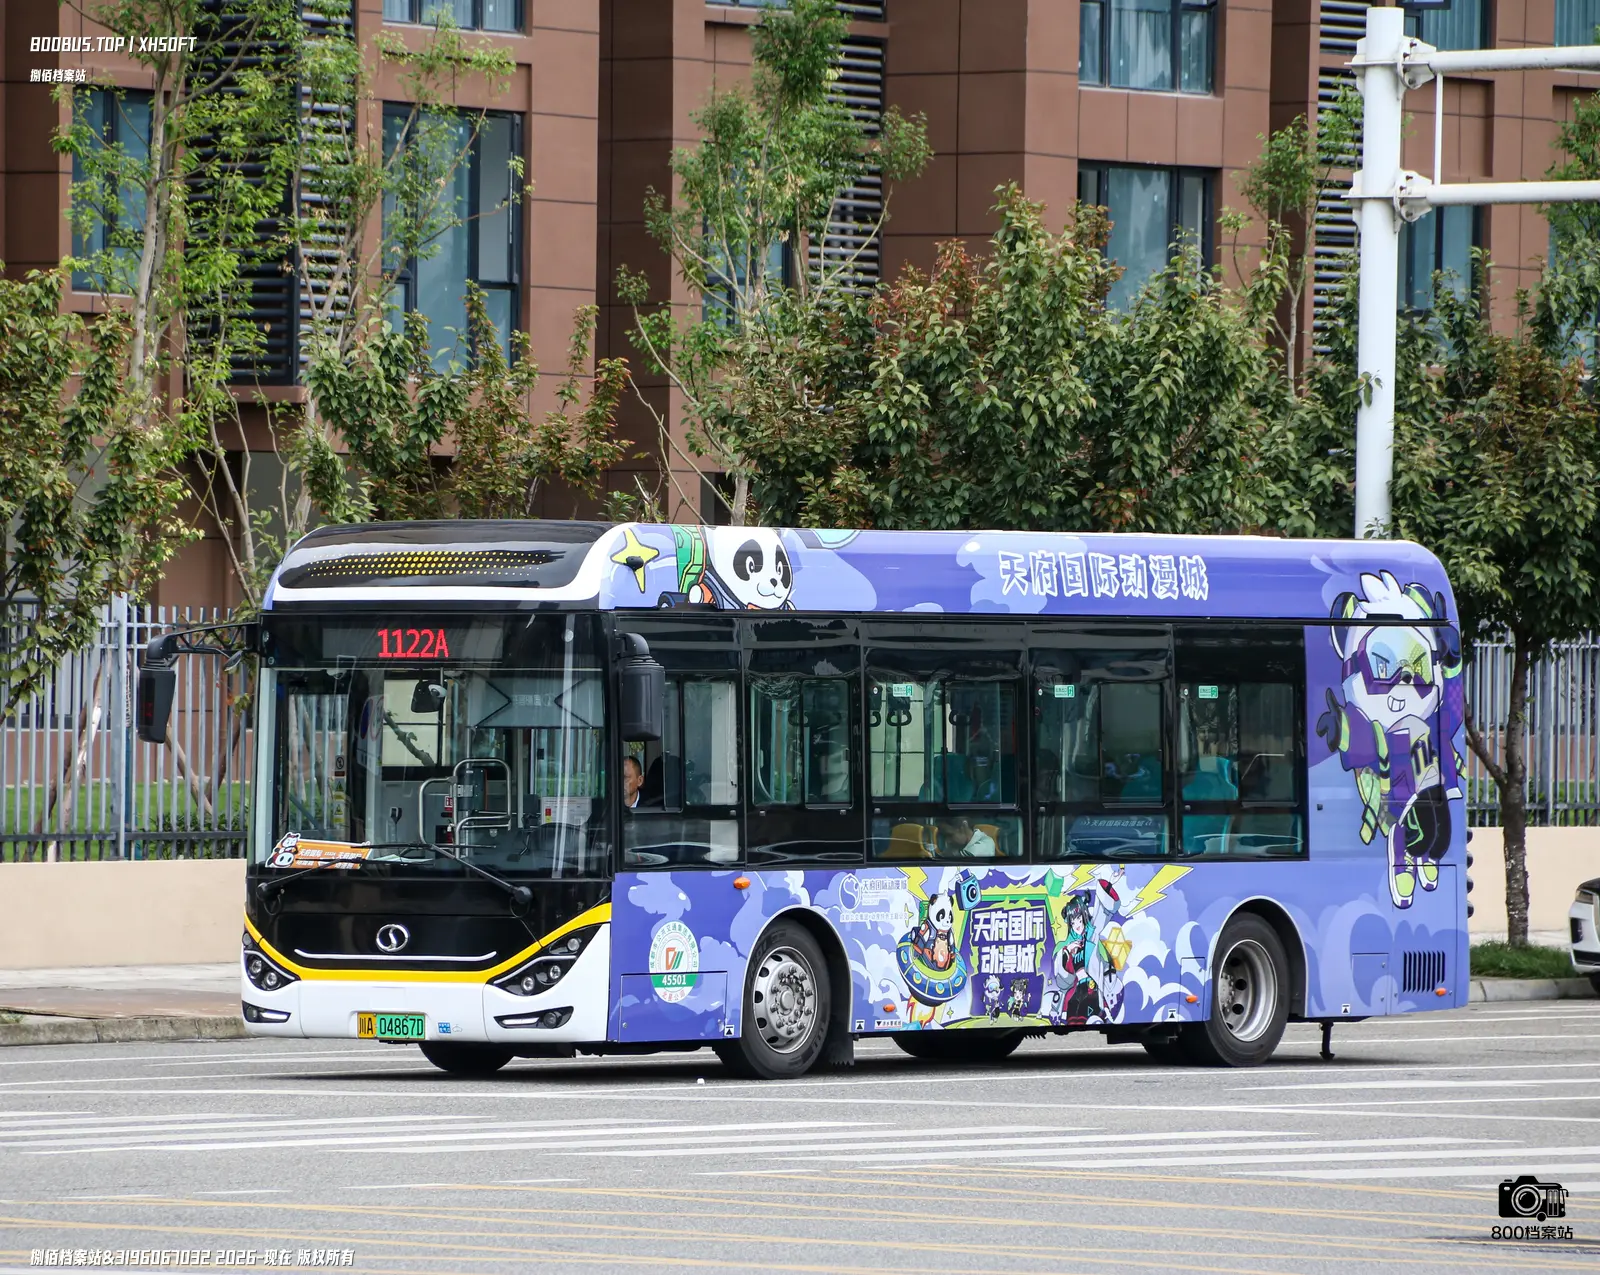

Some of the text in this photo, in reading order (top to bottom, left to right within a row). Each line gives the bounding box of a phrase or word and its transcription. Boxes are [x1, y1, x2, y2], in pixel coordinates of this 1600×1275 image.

[998, 550, 1210, 600] 天府国际动漫城
[377, 628, 449, 658] 1122A
[973, 910, 1044, 942] 天府国际
[981, 944, 1035, 974] 动漫城
[662, 974, 687, 986] 45501
[359, 1017, 374, 1035] 川A
[380, 1017, 424, 1036] 04867D
